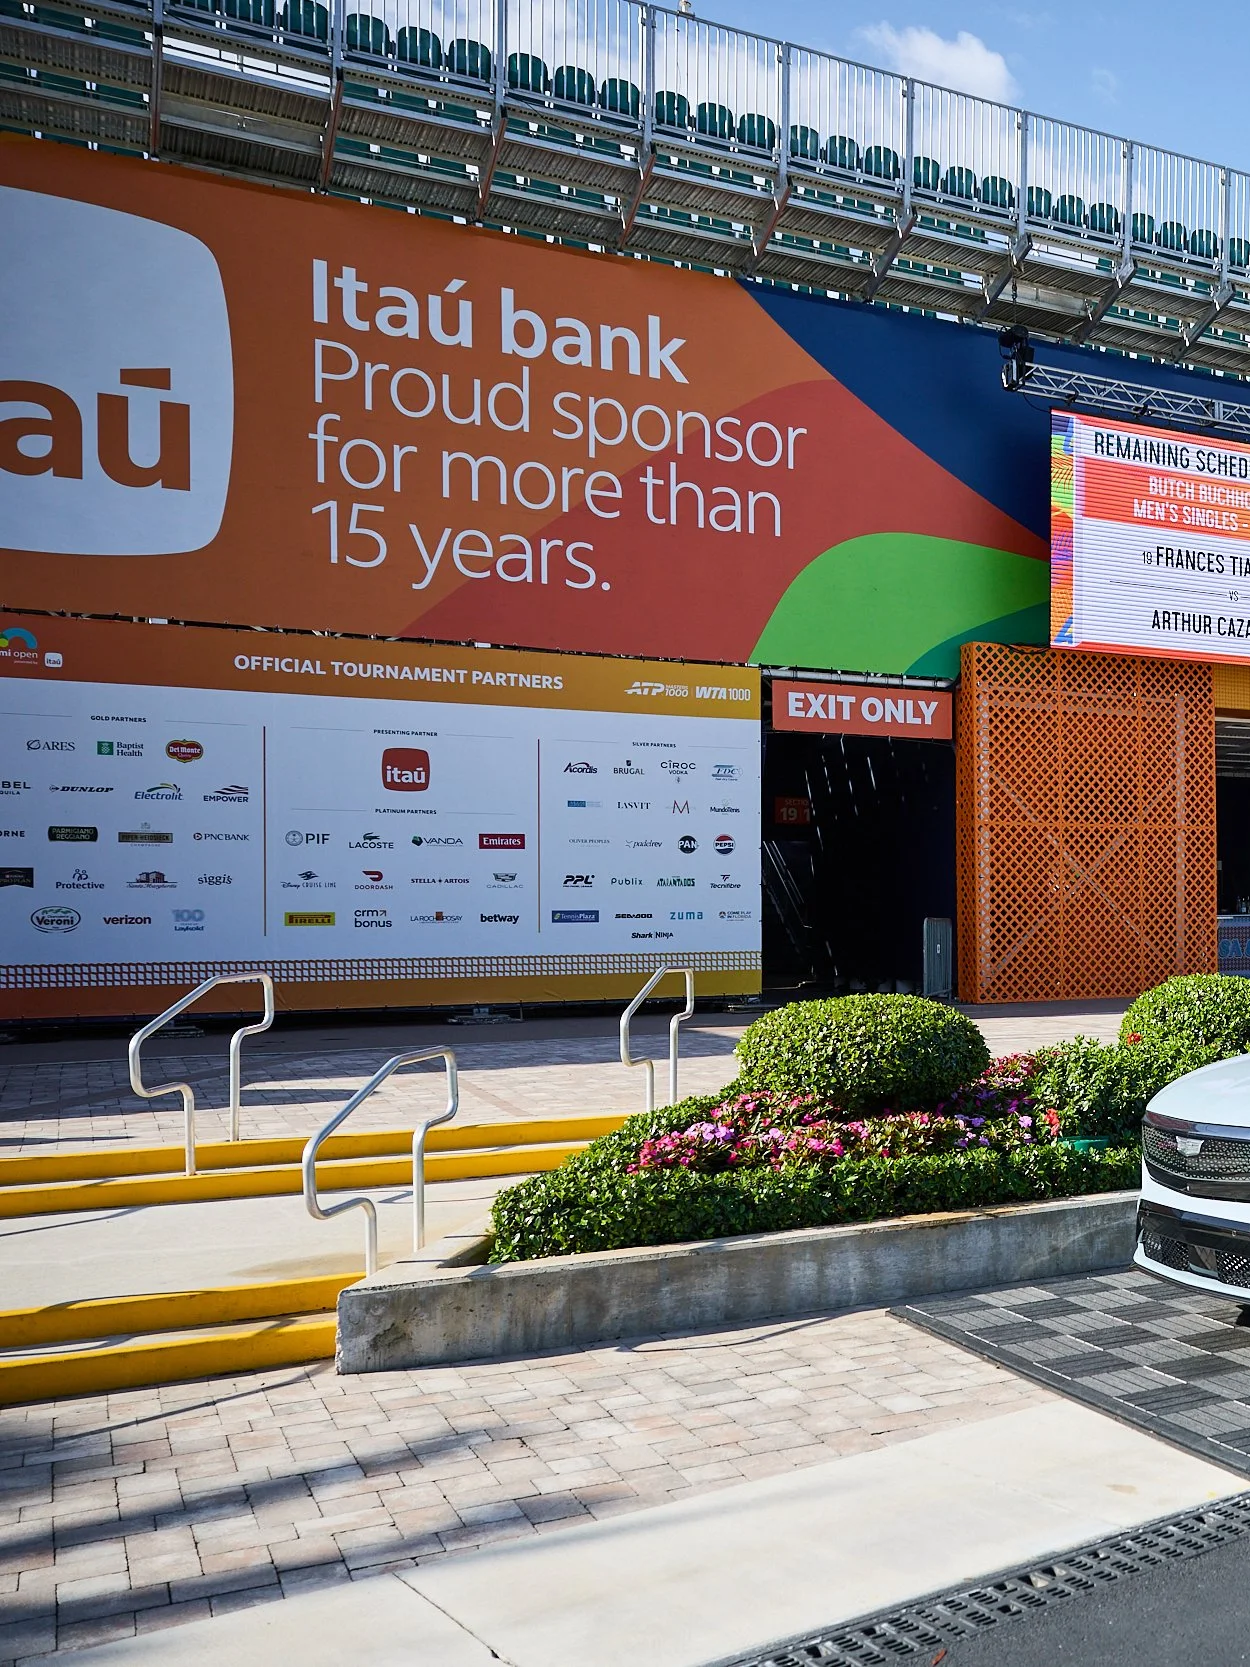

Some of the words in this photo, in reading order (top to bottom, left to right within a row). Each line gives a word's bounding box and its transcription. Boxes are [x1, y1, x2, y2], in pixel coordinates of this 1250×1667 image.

[311, 258, 472, 349] Itaú
[500, 287, 689, 385] bank
[313, 339, 531, 432] Proud
[552, 391, 808, 470] sponsor
[1094, 431, 1190, 469] REMAINING
[309, 413, 418, 493] for
[441, 450, 622, 520] more
[639, 462, 783, 538] than
[1149, 476, 1195, 501] BUTCH
[1133, 499, 1178, 523] MEN'S
[1182, 506, 1239, 532] SINGLES
[311, 500, 388, 568] 15
[409, 522, 612, 591] years.
[1156, 546, 1225, 575] FRANCES
[1229, 590, 1239, 602] VS
[1152, 610, 1213, 636] ARTHUR
[13, 651, 38, 659] open
[234, 655, 327, 675] OFFICIAL
[331, 661, 467, 685] TOURNAMENT
[471, 671, 564, 690] PARTNERS
[624, 682, 665, 696] ATP
[665, 689, 689, 698] 1000
[695, 686, 727, 700] WTA
[728, 688, 751, 701] 1000
[787, 691, 856, 720] EXIT
[860, 697, 939, 725] ONLY
[42, 741, 76, 751] ARES
[116, 742, 144, 750] Baptist
[116, 749, 143, 757] Health
[564, 762, 598, 774] Acordis
[613, 767, 645, 775] BRUGAL
[386, 765, 426, 783] itaú
[134, 791, 183, 801] Electrolit
[203, 795, 249, 803] EMPOWER
[780, 807, 797, 821] 19
[305, 833, 331, 845] PIF
[423, 837, 464, 845] VANDA
[483, 837, 521, 845] Emirates
[348, 841, 394, 849] LACOSTE
[55, 881, 105, 889] Protective
[563, 875, 593, 885] PPL
[610, 877, 643, 885] Publix
[171, 909, 205, 922] 100
[354, 909, 379, 917] crm
[480, 913, 519, 924] betway
[669, 911, 703, 920] zuma
[35, 916, 74, 925] Veroni
[103, 915, 152, 925] verizon
[354, 917, 393, 928] bonus
